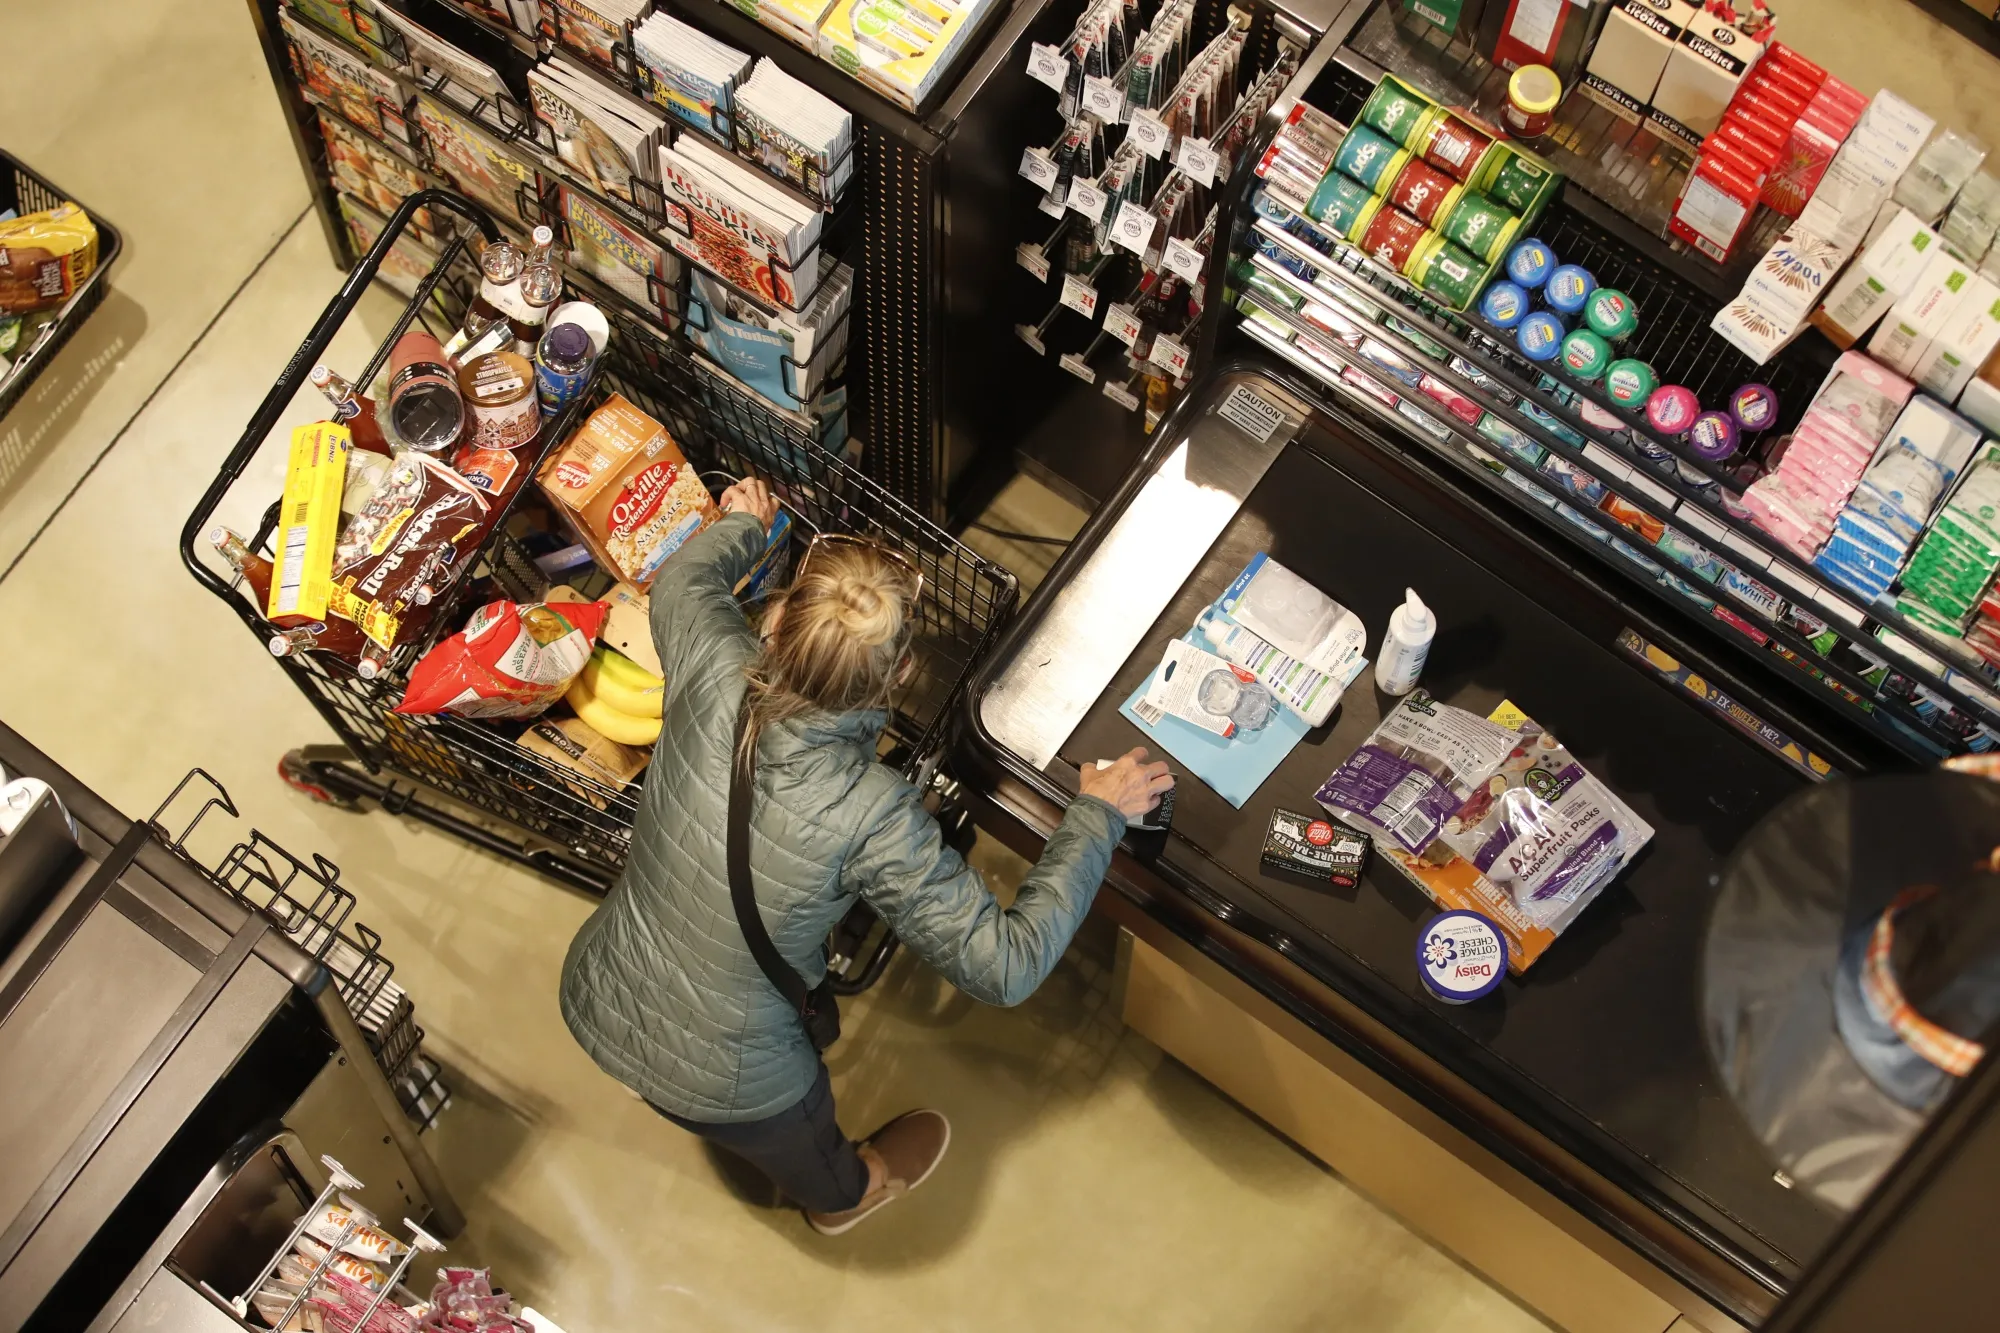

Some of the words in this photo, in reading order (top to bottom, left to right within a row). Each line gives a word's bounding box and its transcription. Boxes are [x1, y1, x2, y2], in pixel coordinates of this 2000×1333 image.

[1623, 2, 1671, 36] LICORICE
[1688, 38, 1736, 72] LICORICE
[1585, 76, 1640, 112] LICORICE
[1378, 98, 1406, 133] Spry
[1348, 143, 1378, 178] Spry
[1403, 181, 1429, 214] Spry
[570, 202, 613, 239] WORD
[613, 235, 651, 272] SEEK
[670, 181, 780, 259] COOKIES
[1459, 212, 1488, 248] Spry
[571, 211, 651, 277] PUZZLES
[1771, 248, 1822, 287] POCKY
[1599, 299, 1617, 323] mentos
[736, 325, 784, 347] Today
[1570, 343, 1595, 363] mentos
[276, 339, 312, 386] HARMONS
[475, 365, 513, 380] STROOPWAFELS
[1611, 376, 1640, 390] mentos
[1237, 388, 1281, 420] CAUTION
[327, 434, 338, 464] LEIBNIZ
[611, 462, 679, 543] Redenbacher's
[612, 463, 664, 525] Orville
[636, 498, 684, 547] NATURALS
[361, 553, 405, 597] Roll
[1740, 583, 1776, 612] WHITE
[470, 619, 491, 636] FREE
[1716, 694, 1762, 732] EX-SQUEEZE
[1760, 725, 1780, 742] ME?
[1542, 776, 1574, 802] MBAZON
[1272, 832, 1362, 863] PASTURE-RAISED
[1519, 829, 1574, 882] Superfruit
[1570, 806, 1601, 833] Packs
[1472, 875, 1508, 904] THREE
[1498, 900, 1534, 933] CHEESE
[1459, 935, 1494, 949] CHEESE
[1459, 944, 1498, 959] COTTAGE
[1455, 963, 1491, 979] Daisy
